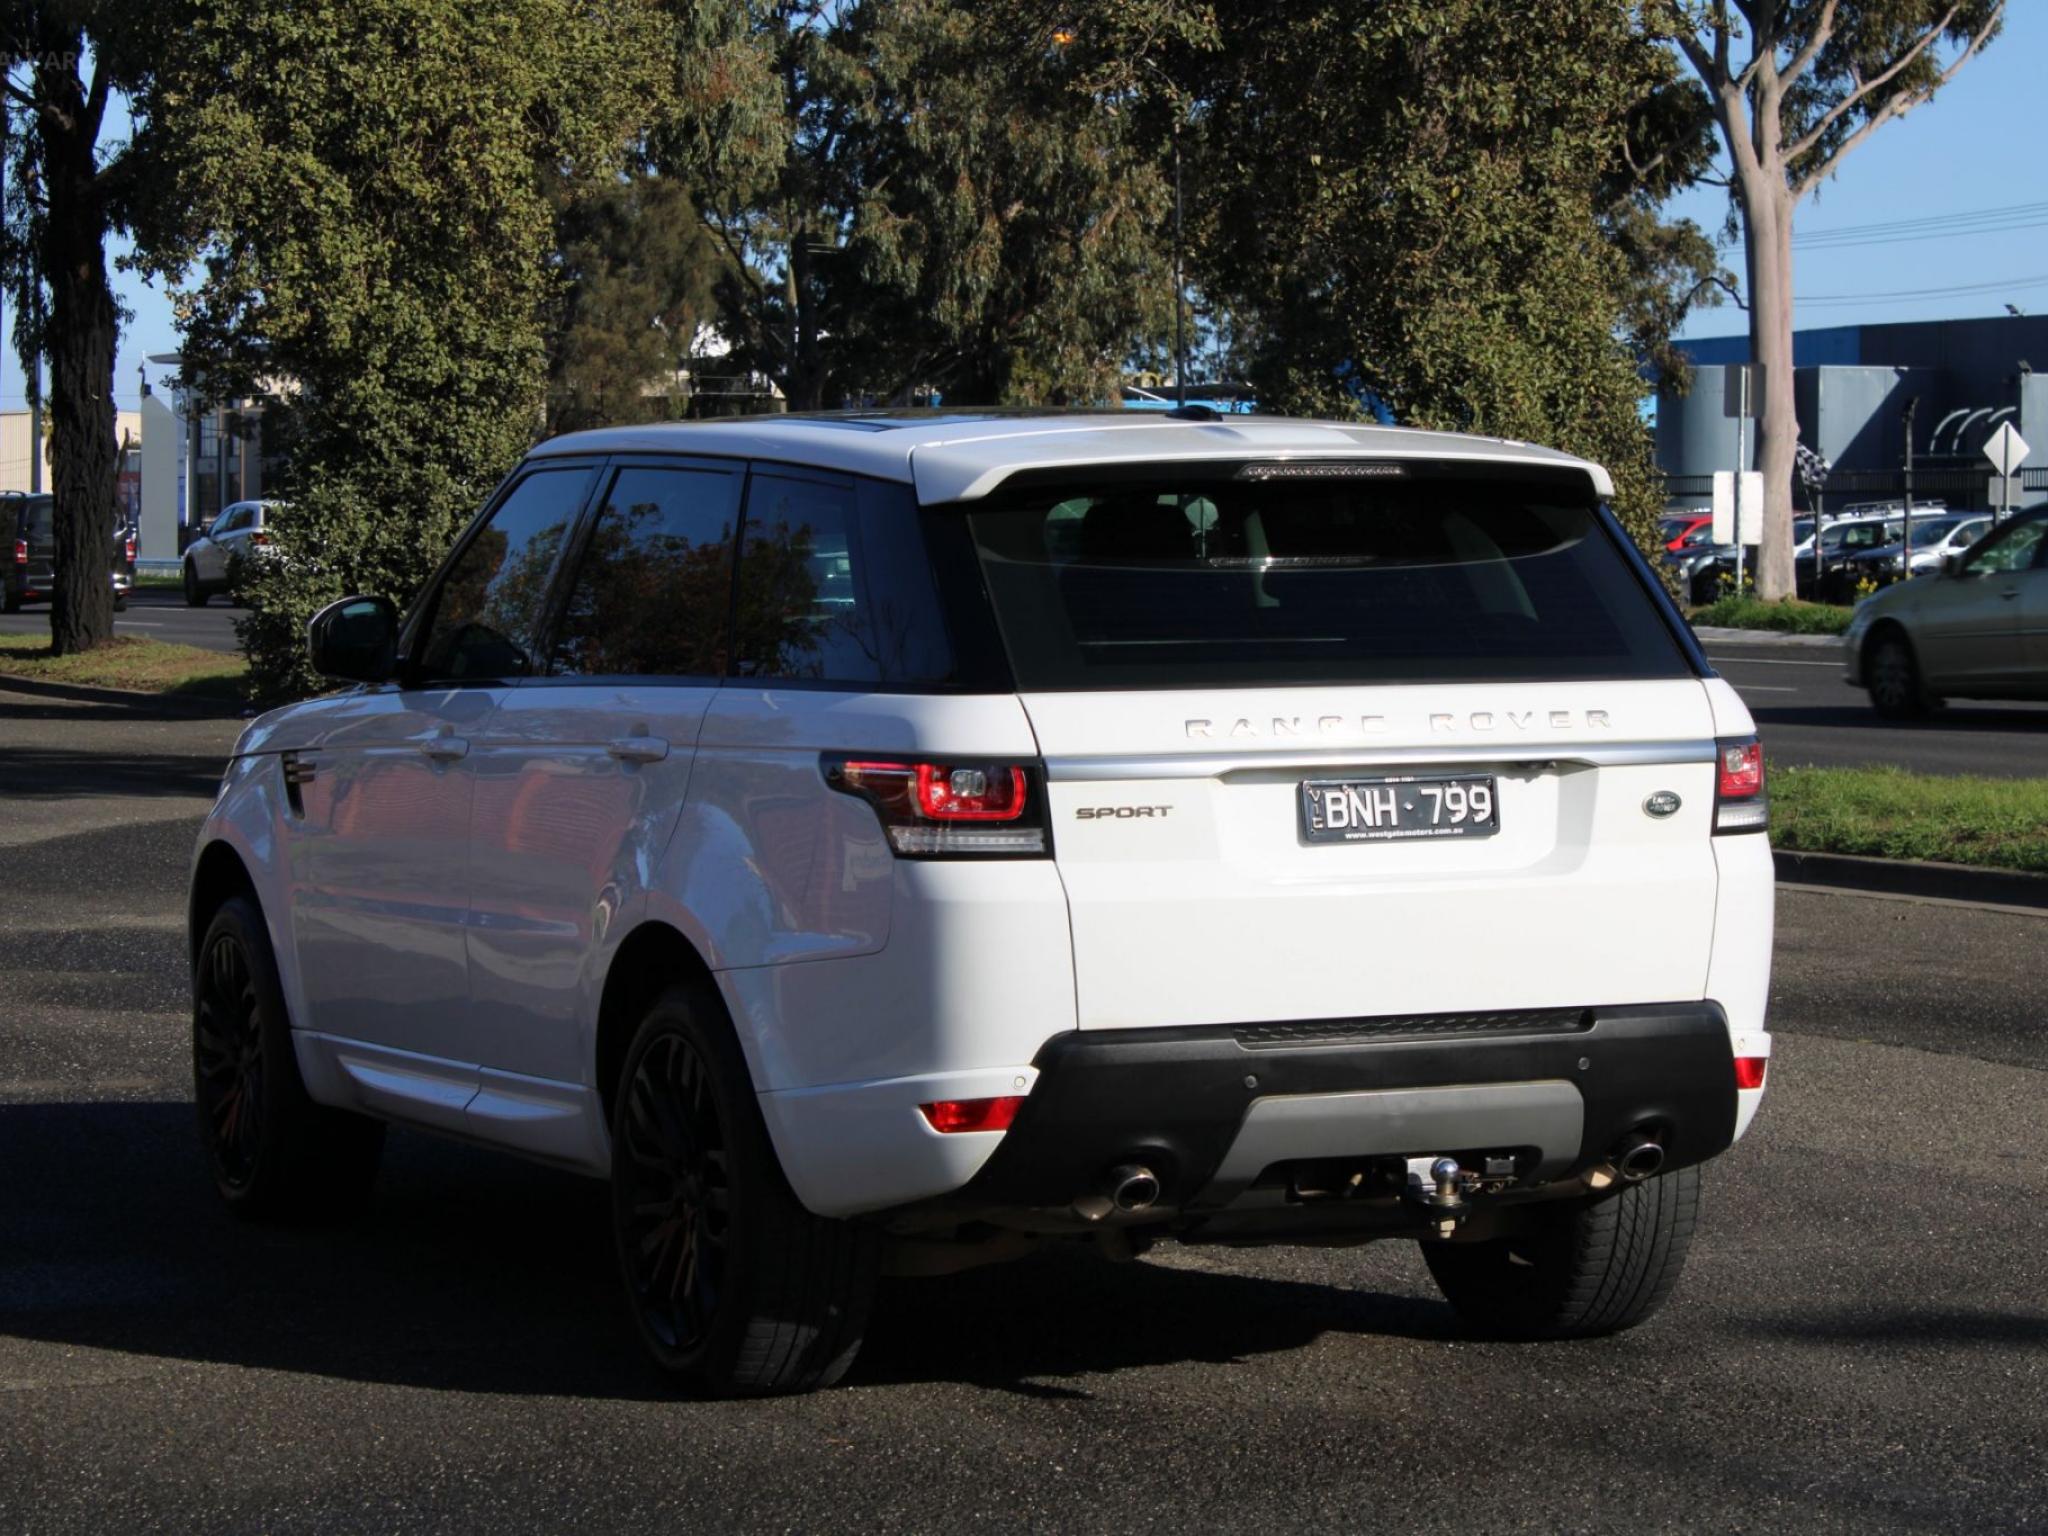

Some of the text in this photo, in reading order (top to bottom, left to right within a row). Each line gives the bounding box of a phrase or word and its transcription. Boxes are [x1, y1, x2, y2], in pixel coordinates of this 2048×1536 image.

[1185, 710, 1612, 738] RANGE ROVER
[1076, 805, 1174, 820] SPORT
[1324, 784, 1493, 829] BNH 799
